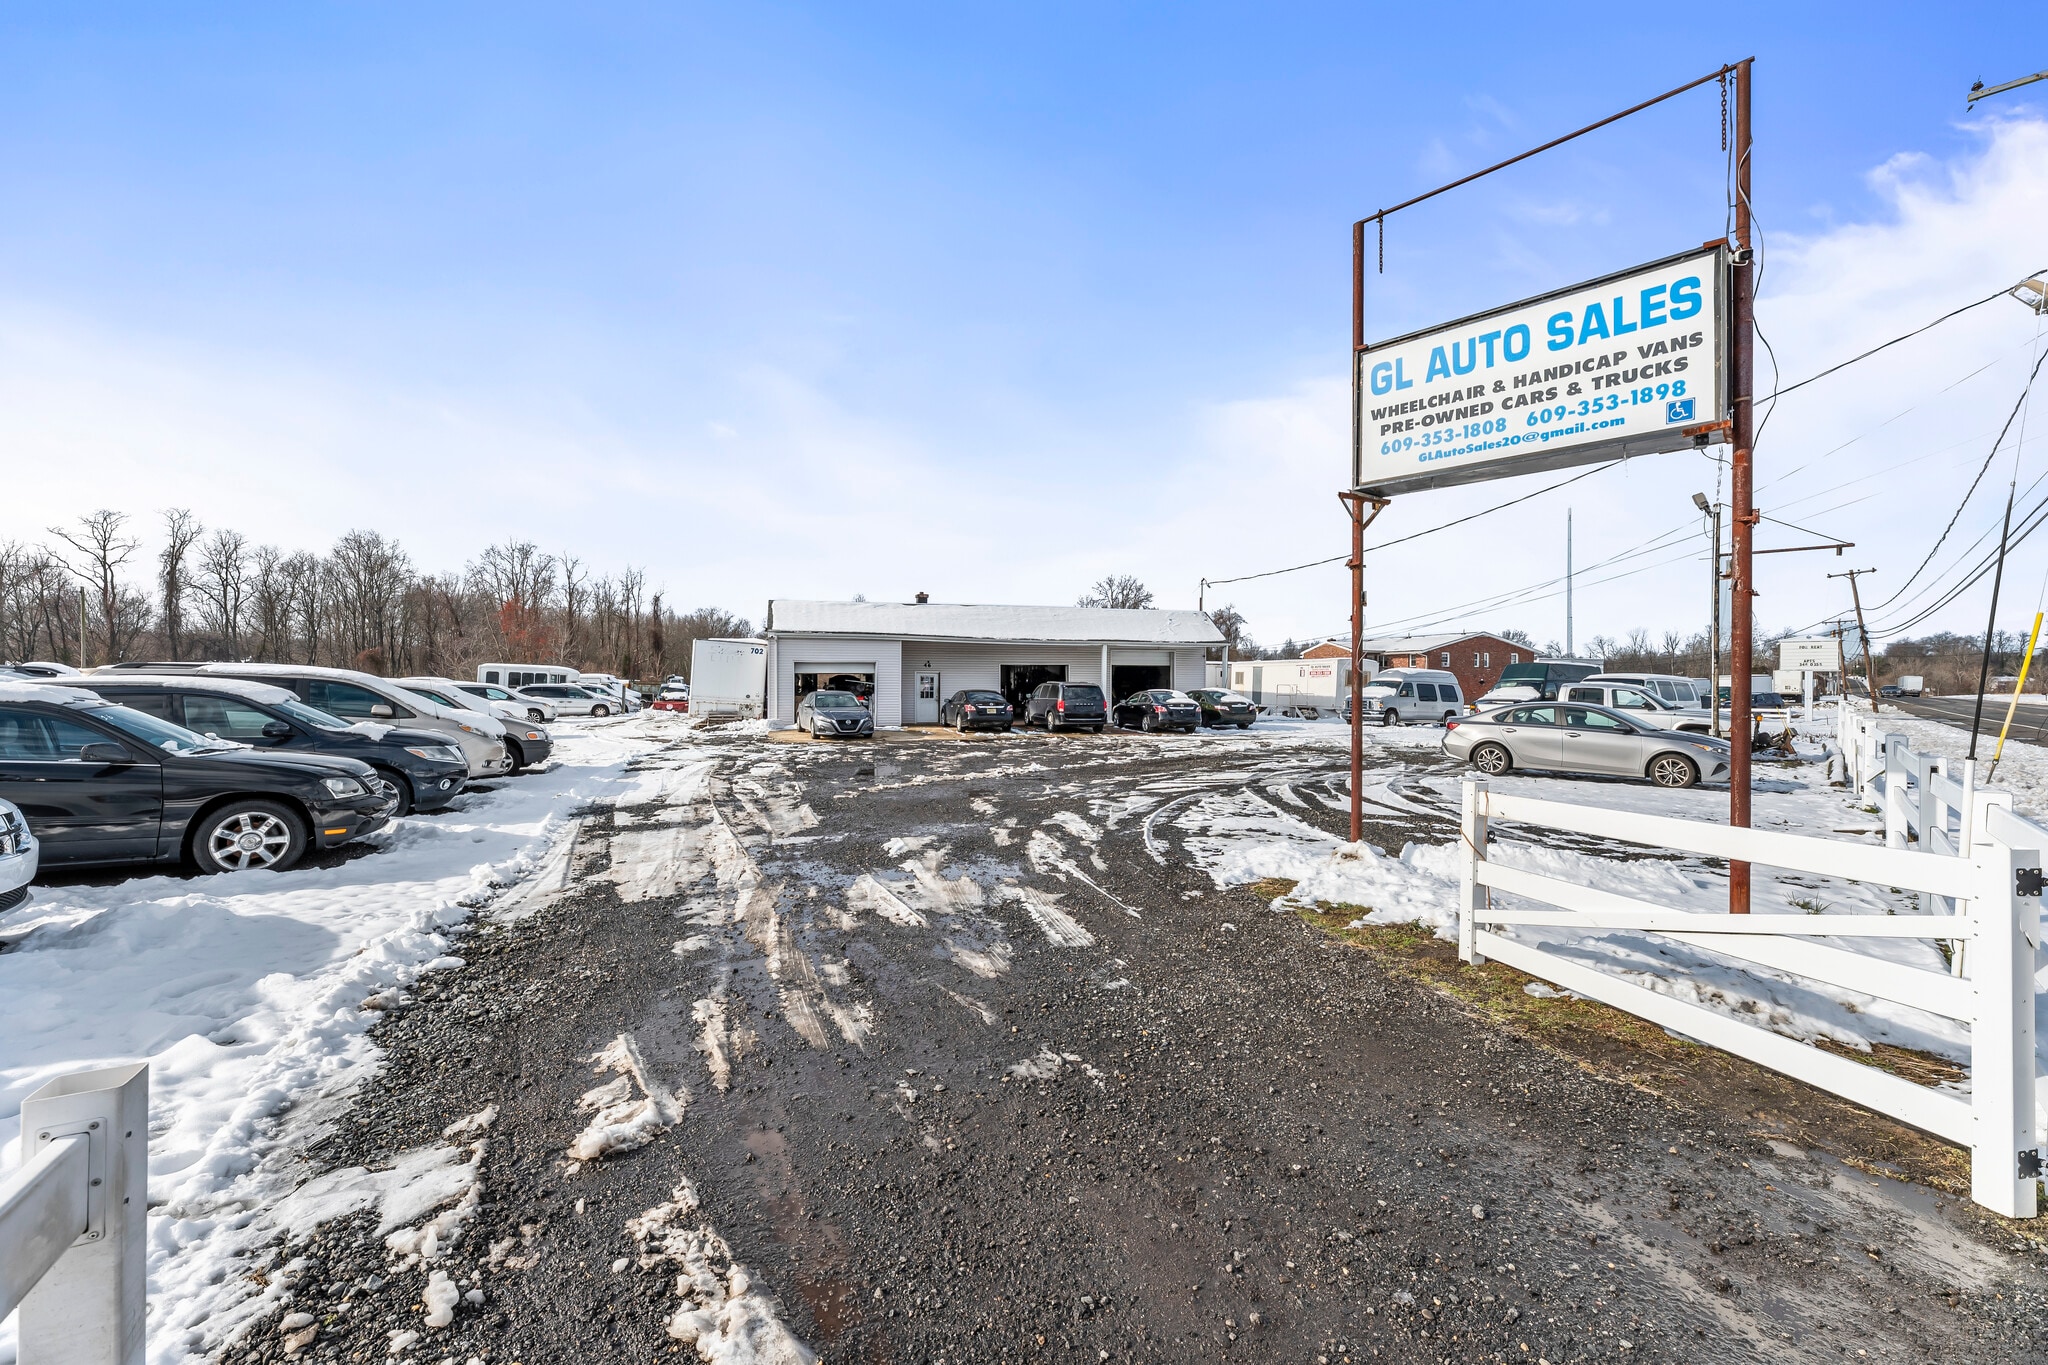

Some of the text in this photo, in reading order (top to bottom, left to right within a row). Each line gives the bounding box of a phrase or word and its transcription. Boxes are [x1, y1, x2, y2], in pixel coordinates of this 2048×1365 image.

[1370, 276, 1703, 396] GL AUTO SALES
[1370, 331, 1704, 422] WHEELCHAIR & HANDICAP VANS
[1380, 356, 1689, 437] PRE-OWNED CARS & TRUCKS
[1380, 379, 1686, 456] 609-353-1808 609-353-1898
[1418, 417, 1625, 463] GLAutoSales20@gmail.com
[750, 647, 764, 655] 702
